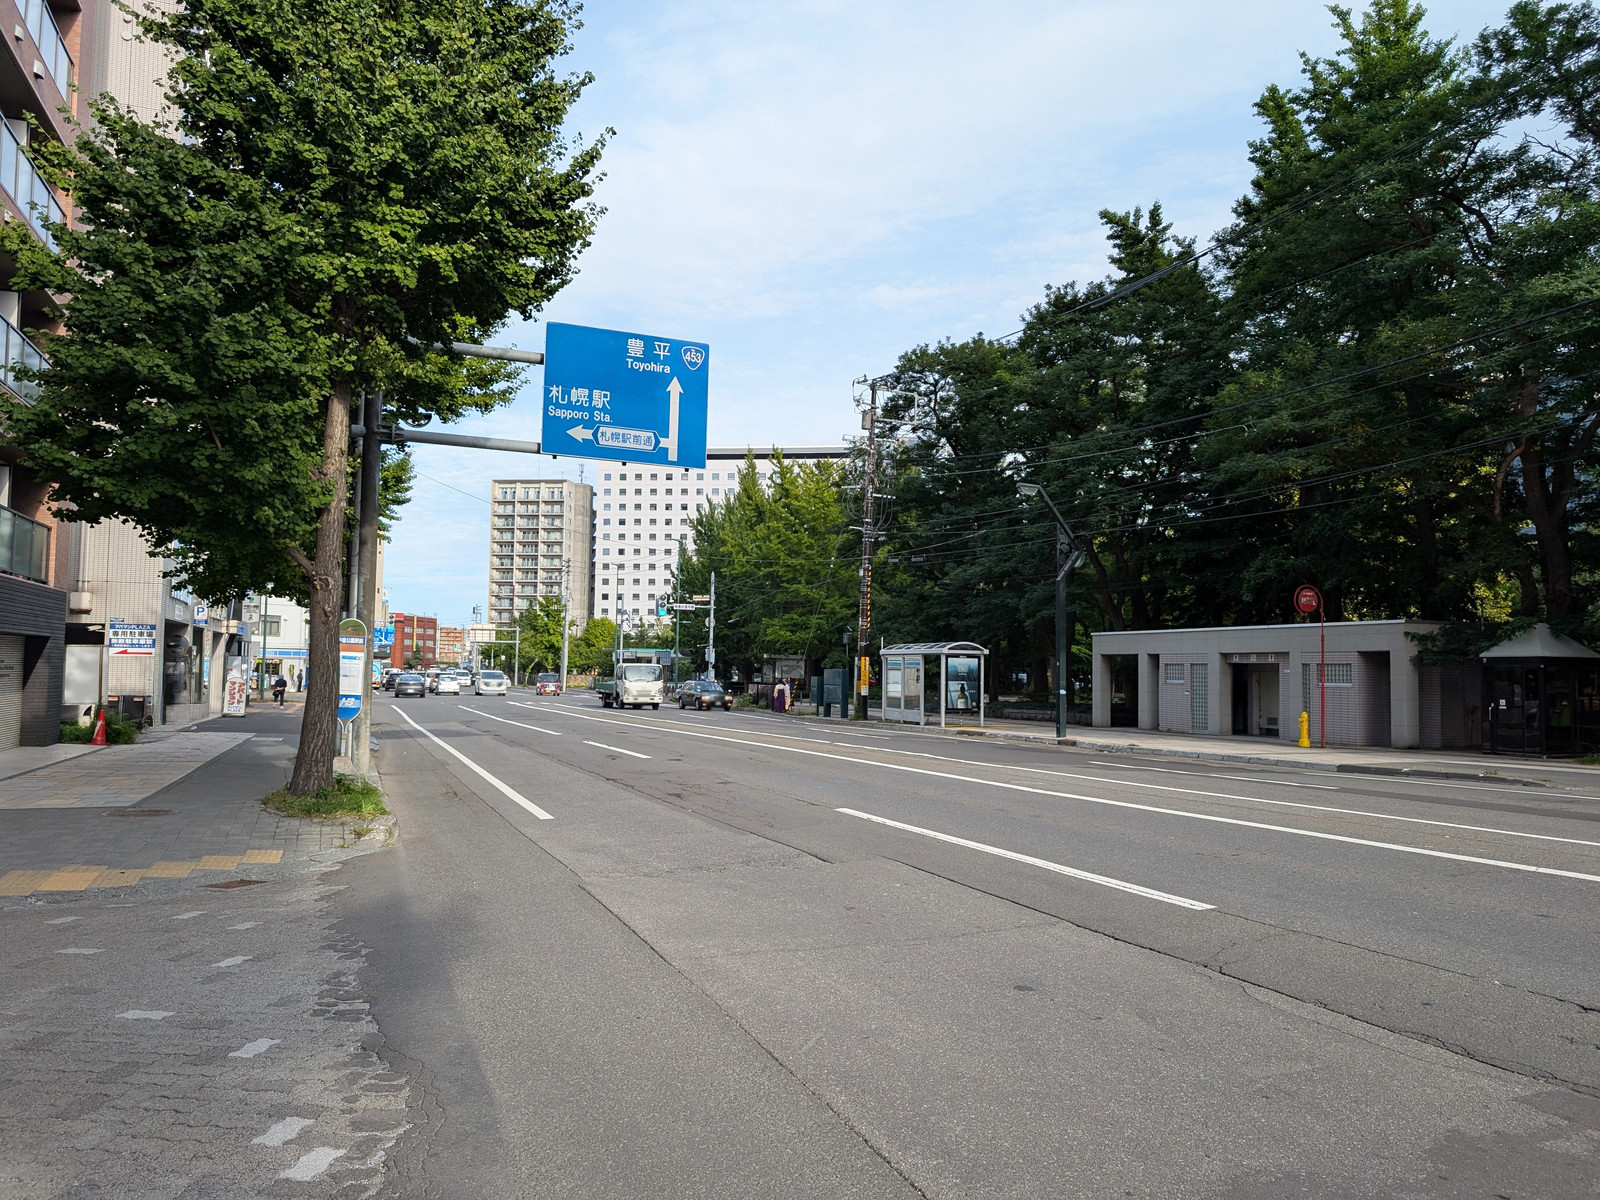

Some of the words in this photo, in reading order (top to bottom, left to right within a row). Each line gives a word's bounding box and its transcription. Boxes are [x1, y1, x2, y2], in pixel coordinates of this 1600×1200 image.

[626, 338, 671, 360] 豊平
[685, 352, 702, 363] 453
[626, 359, 671, 374] Toyohira
[548, 385, 611, 410] 札幌駅
[548, 406, 589, 420] Sapporo
[593, 411, 613, 423] Sta.
[599, 430, 653, 447] 札幌駅前通
[196, 606, 205, 616] P
